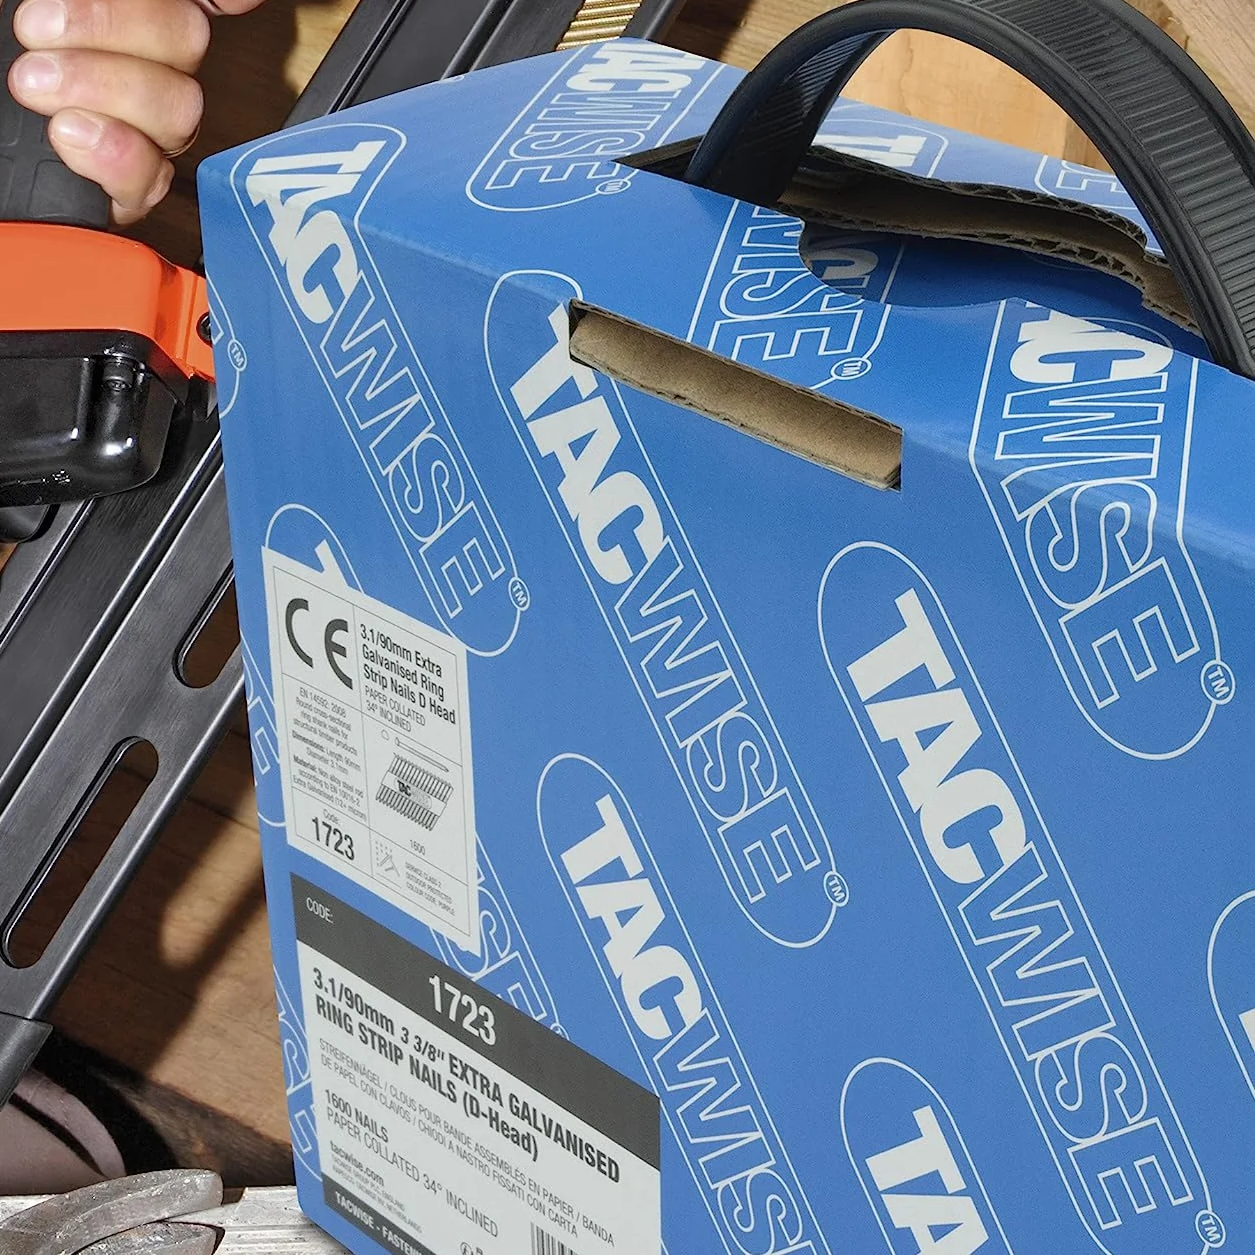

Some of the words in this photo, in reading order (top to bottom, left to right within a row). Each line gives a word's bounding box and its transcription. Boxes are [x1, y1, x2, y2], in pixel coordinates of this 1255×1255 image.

[485, 42, 705, 190] ACWISE
[246, 140, 505, 619] TACWISE
[995, 302, 1201, 709] ACWISE
[360, 623, 411, 661] 3.1/90mm
[415, 651, 441, 676] Extra
[511, 301, 820, 904] TACWISE
[362, 643, 417, 683] Galvanised
[420, 673, 444, 701] Ring
[363, 664, 387, 691] Strip
[390, 677, 415, 702] Nails
[419, 692, 425, 708] D
[429, 698, 455, 723] Head
[365, 685, 387, 705] PAPER
[389, 698, 425, 726] COLLATED
[311, 815, 354, 861] 1723
[306, 897, 334, 923] CODE:
[846, 588, 1193, 1230] TACWISE
[429, 975, 496, 1046] 1723
[561, 794, 818, 1255] TACWIS
[313, 967, 394, 1035] 3.1/90mm
[400, 1024, 409, 1046] 3
[449, 1054, 503, 1105] EXTRA
[509, 1093, 619, 1183] GALVANISED
[315, 995, 353, 1034] RING
[357, 1022, 403, 1067] STRIP
[409, 1055, 456, 1103] NAILS
[463, 1091, 538, 1162] (D-Head)
[325, 1089, 352, 1117] 1600
[354, 1108, 388, 1142] NAILS
[326, 1107, 360, 1141] PAPER
[363, 1132, 419, 1182] COLLATED
[446, 1190, 498, 1238] INCLINED
[444, 1121, 472, 1150] BANDE
[528, 1178, 539, 1196] EN
[542, 1188, 573, 1219] PAPIER
[582, 1215, 613, 1246] BANDA
[456, 1145, 489, 1177] NASTRO
[492, 1169, 524, 1201] FISSATI
[527, 1193, 545, 1216] CON
[548, 1208, 577, 1238] CARTA
